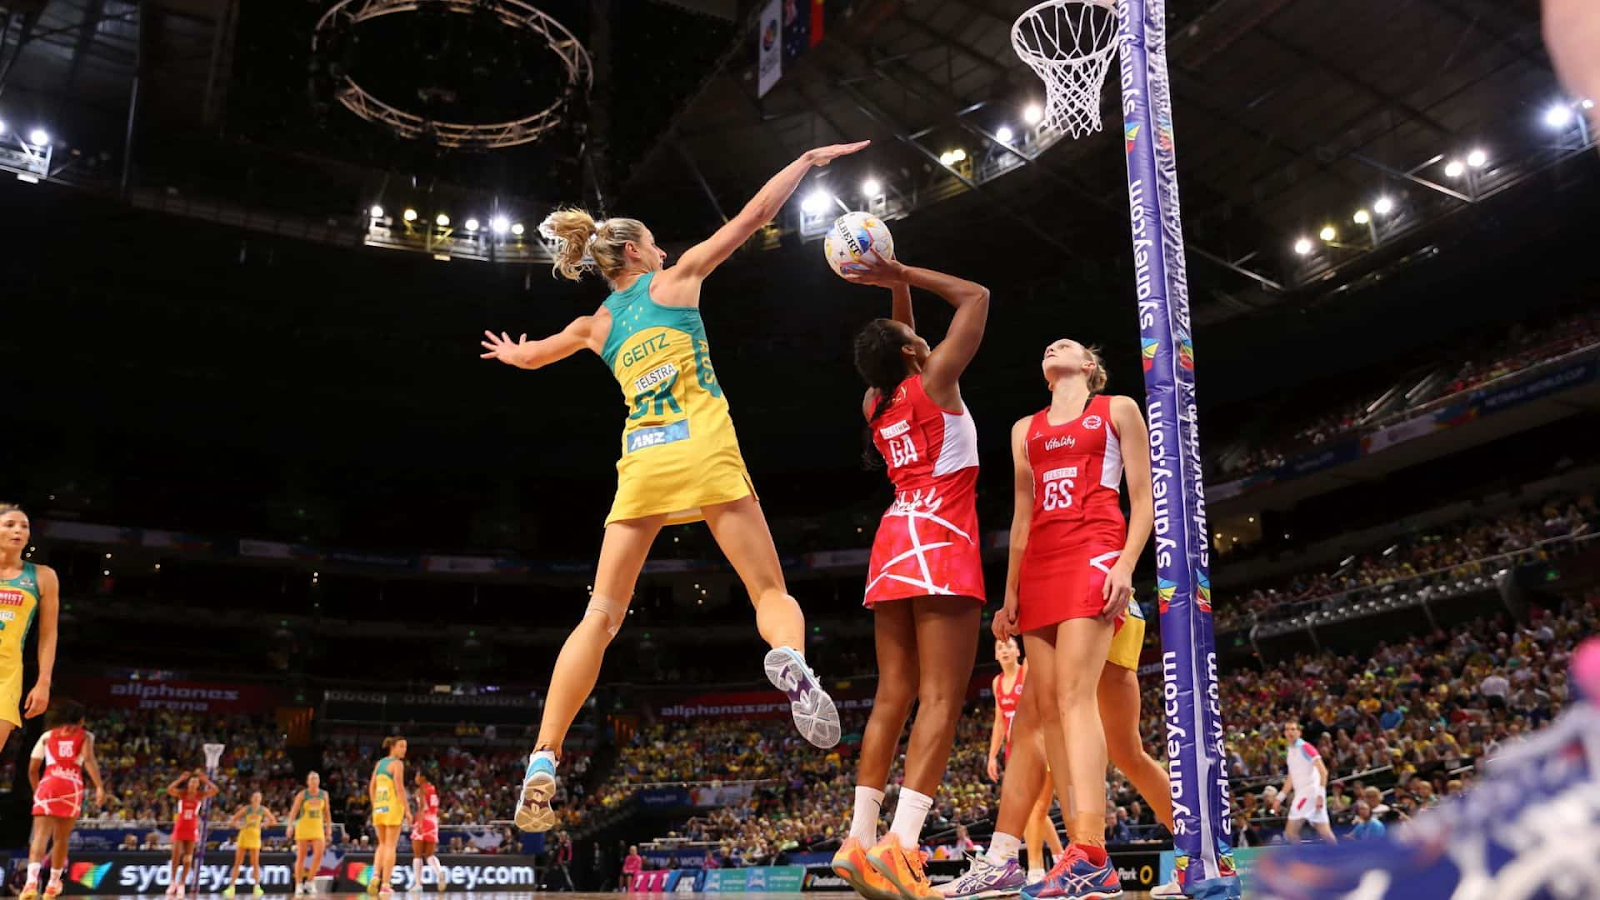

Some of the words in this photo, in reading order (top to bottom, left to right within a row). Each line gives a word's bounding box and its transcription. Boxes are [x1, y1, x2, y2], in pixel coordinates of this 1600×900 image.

[1118, 0, 1137, 116] sydney.co
[1129, 179, 1159, 330] sydney.com
[622, 333, 670, 368] GEITZ
[635, 364, 676, 391] TELSTRA
[631, 432, 666, 450] ANZ
[889, 434, 918, 468] GA
[1045, 435, 1075, 451] Vitality
[1043, 479, 1074, 511] GS
[1149, 402, 1176, 568] sydney.com
[110, 683, 239, 701] allphones
[139, 699, 209, 712] arena
[1162, 651, 1190, 835] sydney.com
[1206, 652, 1231, 835] sydneycom
